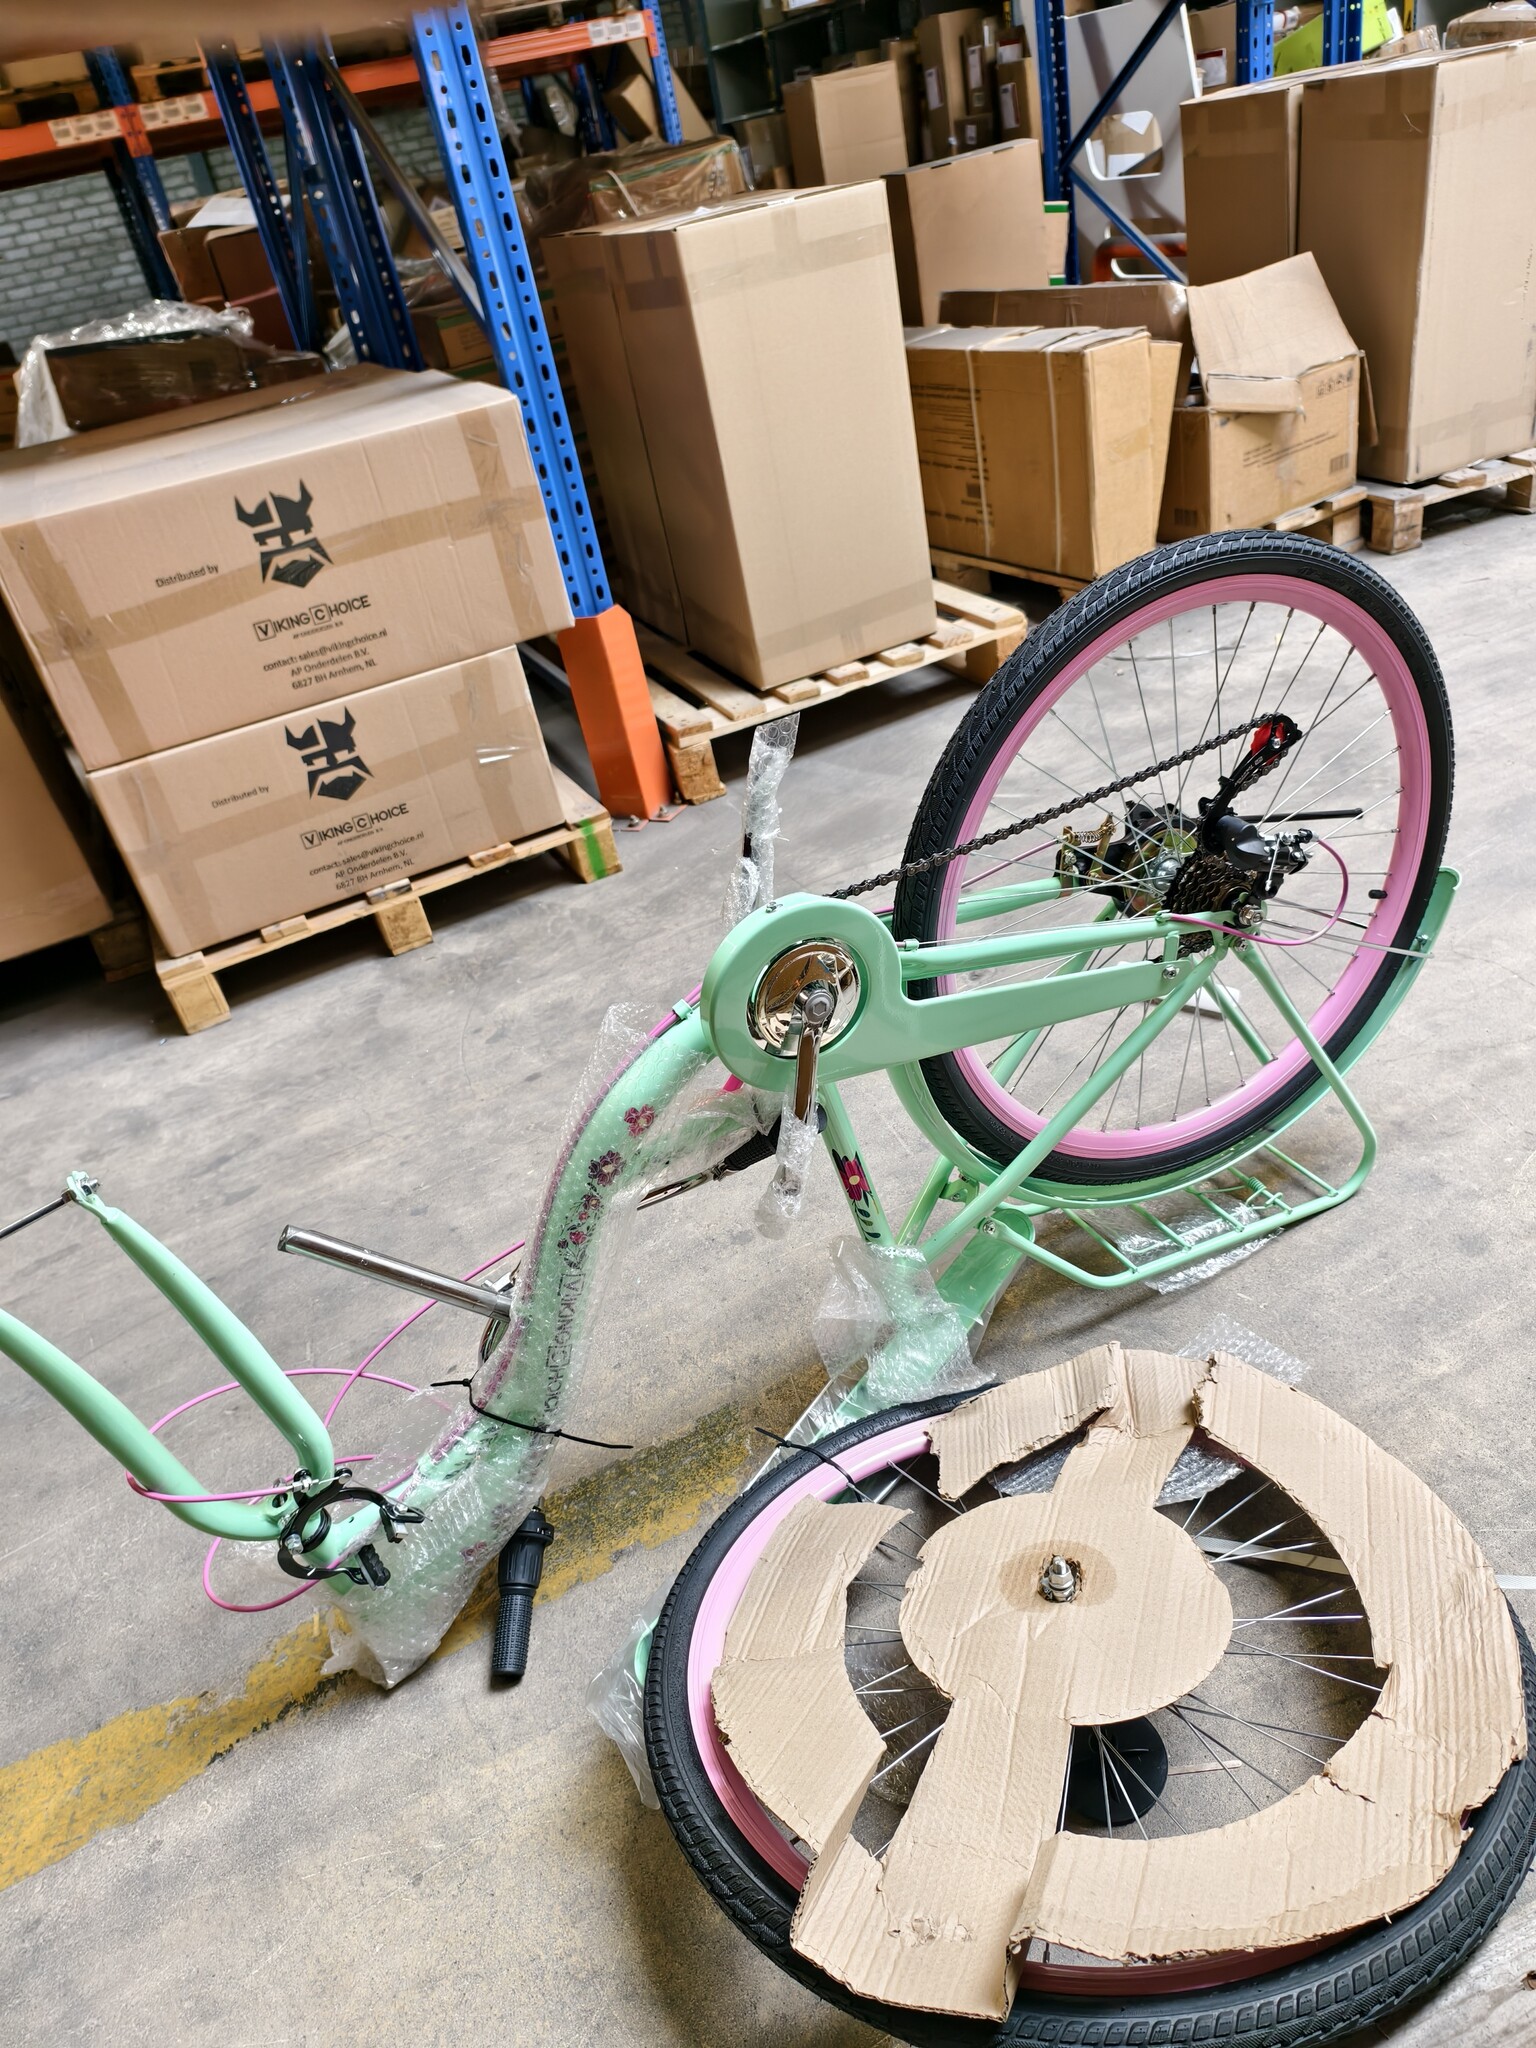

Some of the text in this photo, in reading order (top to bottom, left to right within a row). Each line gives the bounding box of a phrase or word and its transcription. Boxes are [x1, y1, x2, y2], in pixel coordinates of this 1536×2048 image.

[155, 564, 219, 588] Distributed by
[254, 613, 311, 640] VIKING
[311, 594, 371, 624] CHOICE
[263, 656, 298, 672] contact:
[299, 628, 388, 661] sales@vikingchoice.nl
[291, 647, 369, 677] AP Onderdelen B.V.
[292, 658, 378, 690] 6827 BH Arnhem, NL
[211, 788, 258, 808] Distributed
[302, 821, 354, 848] VIKING
[353, 803, 409, 831] CHOICE
[309, 861, 341, 876] contact:
[342, 831, 424, 865] sales@vikingchoice.nl
[335, 850, 407, 879] AP Onderdelen B.V.
[336, 858, 414, 890] 6827 BH Arnhem, NL
[555, 1274, 584, 1345] VIKING
